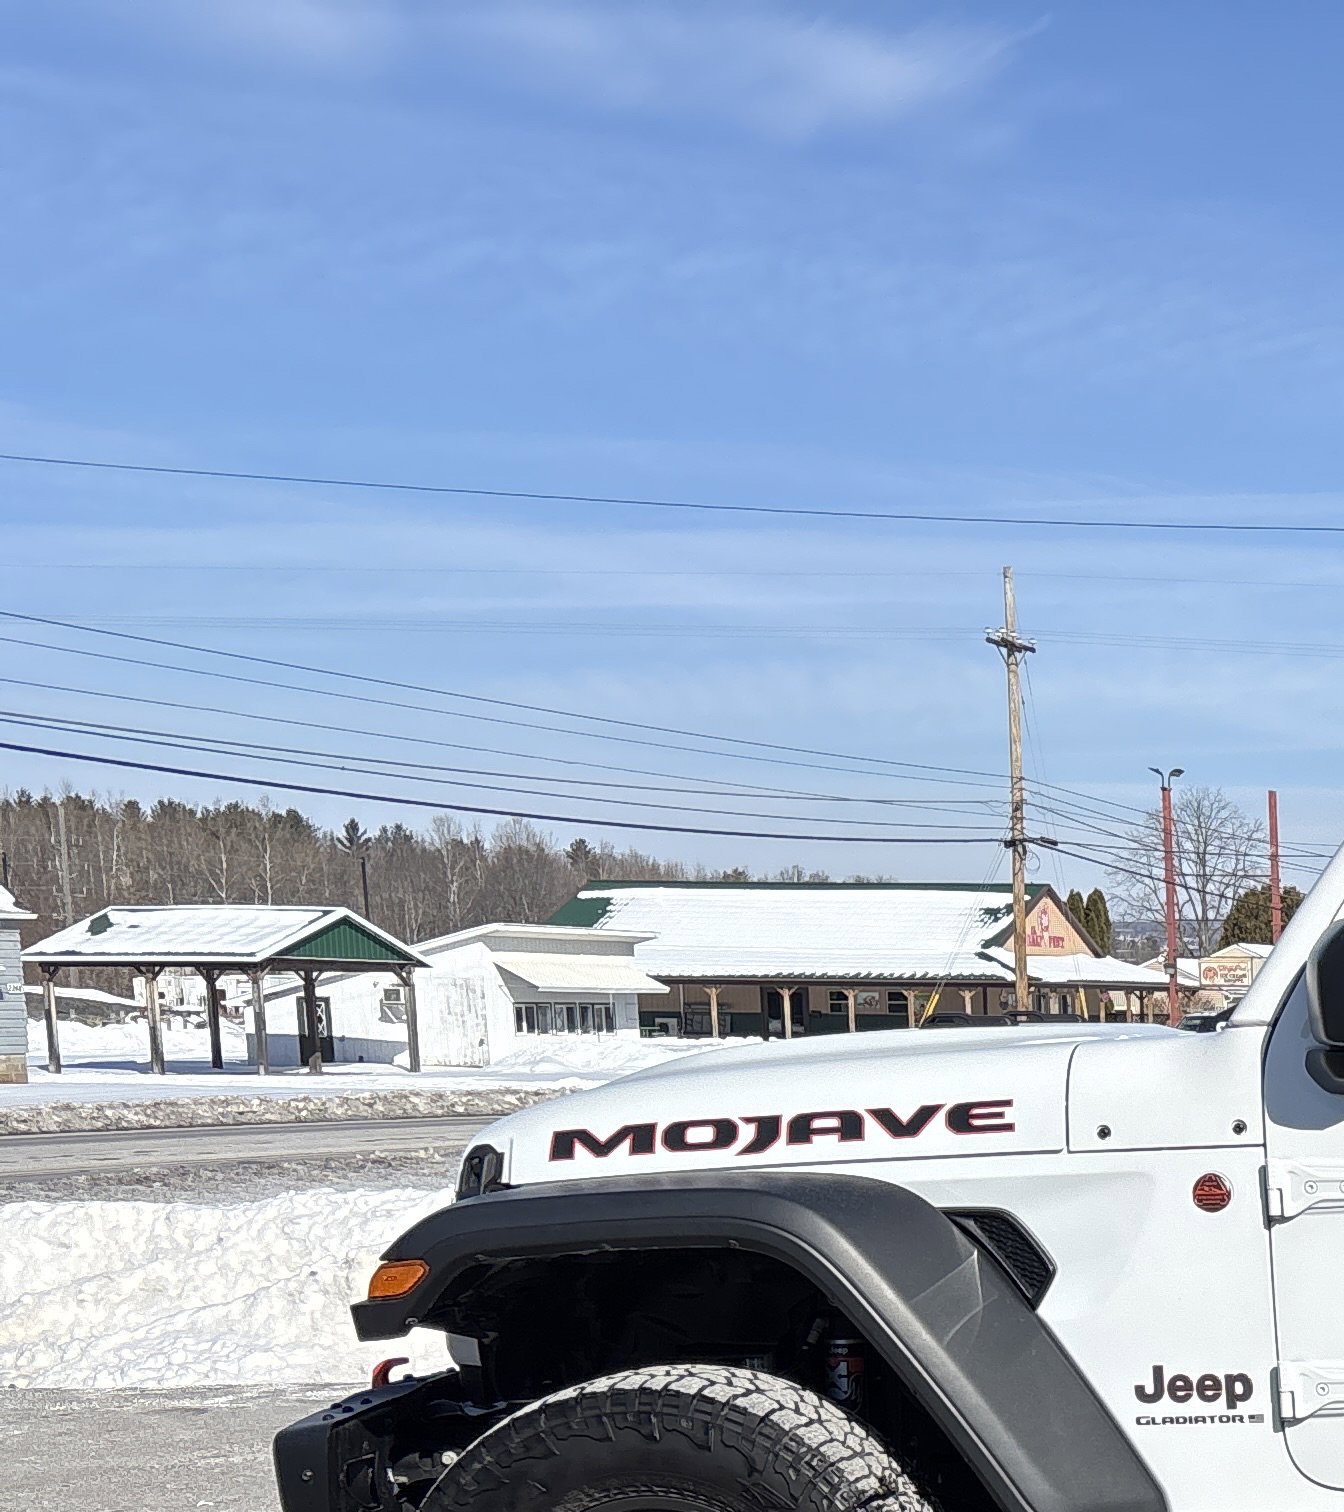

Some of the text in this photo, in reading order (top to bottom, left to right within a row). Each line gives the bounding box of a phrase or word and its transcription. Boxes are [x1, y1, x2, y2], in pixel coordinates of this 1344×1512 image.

[548, 1098, 1015, 1162] MOJAVE
[1134, 1365, 1253, 1410] Jeep
[1135, 1414, 1246, 1426] GLADIATOR
